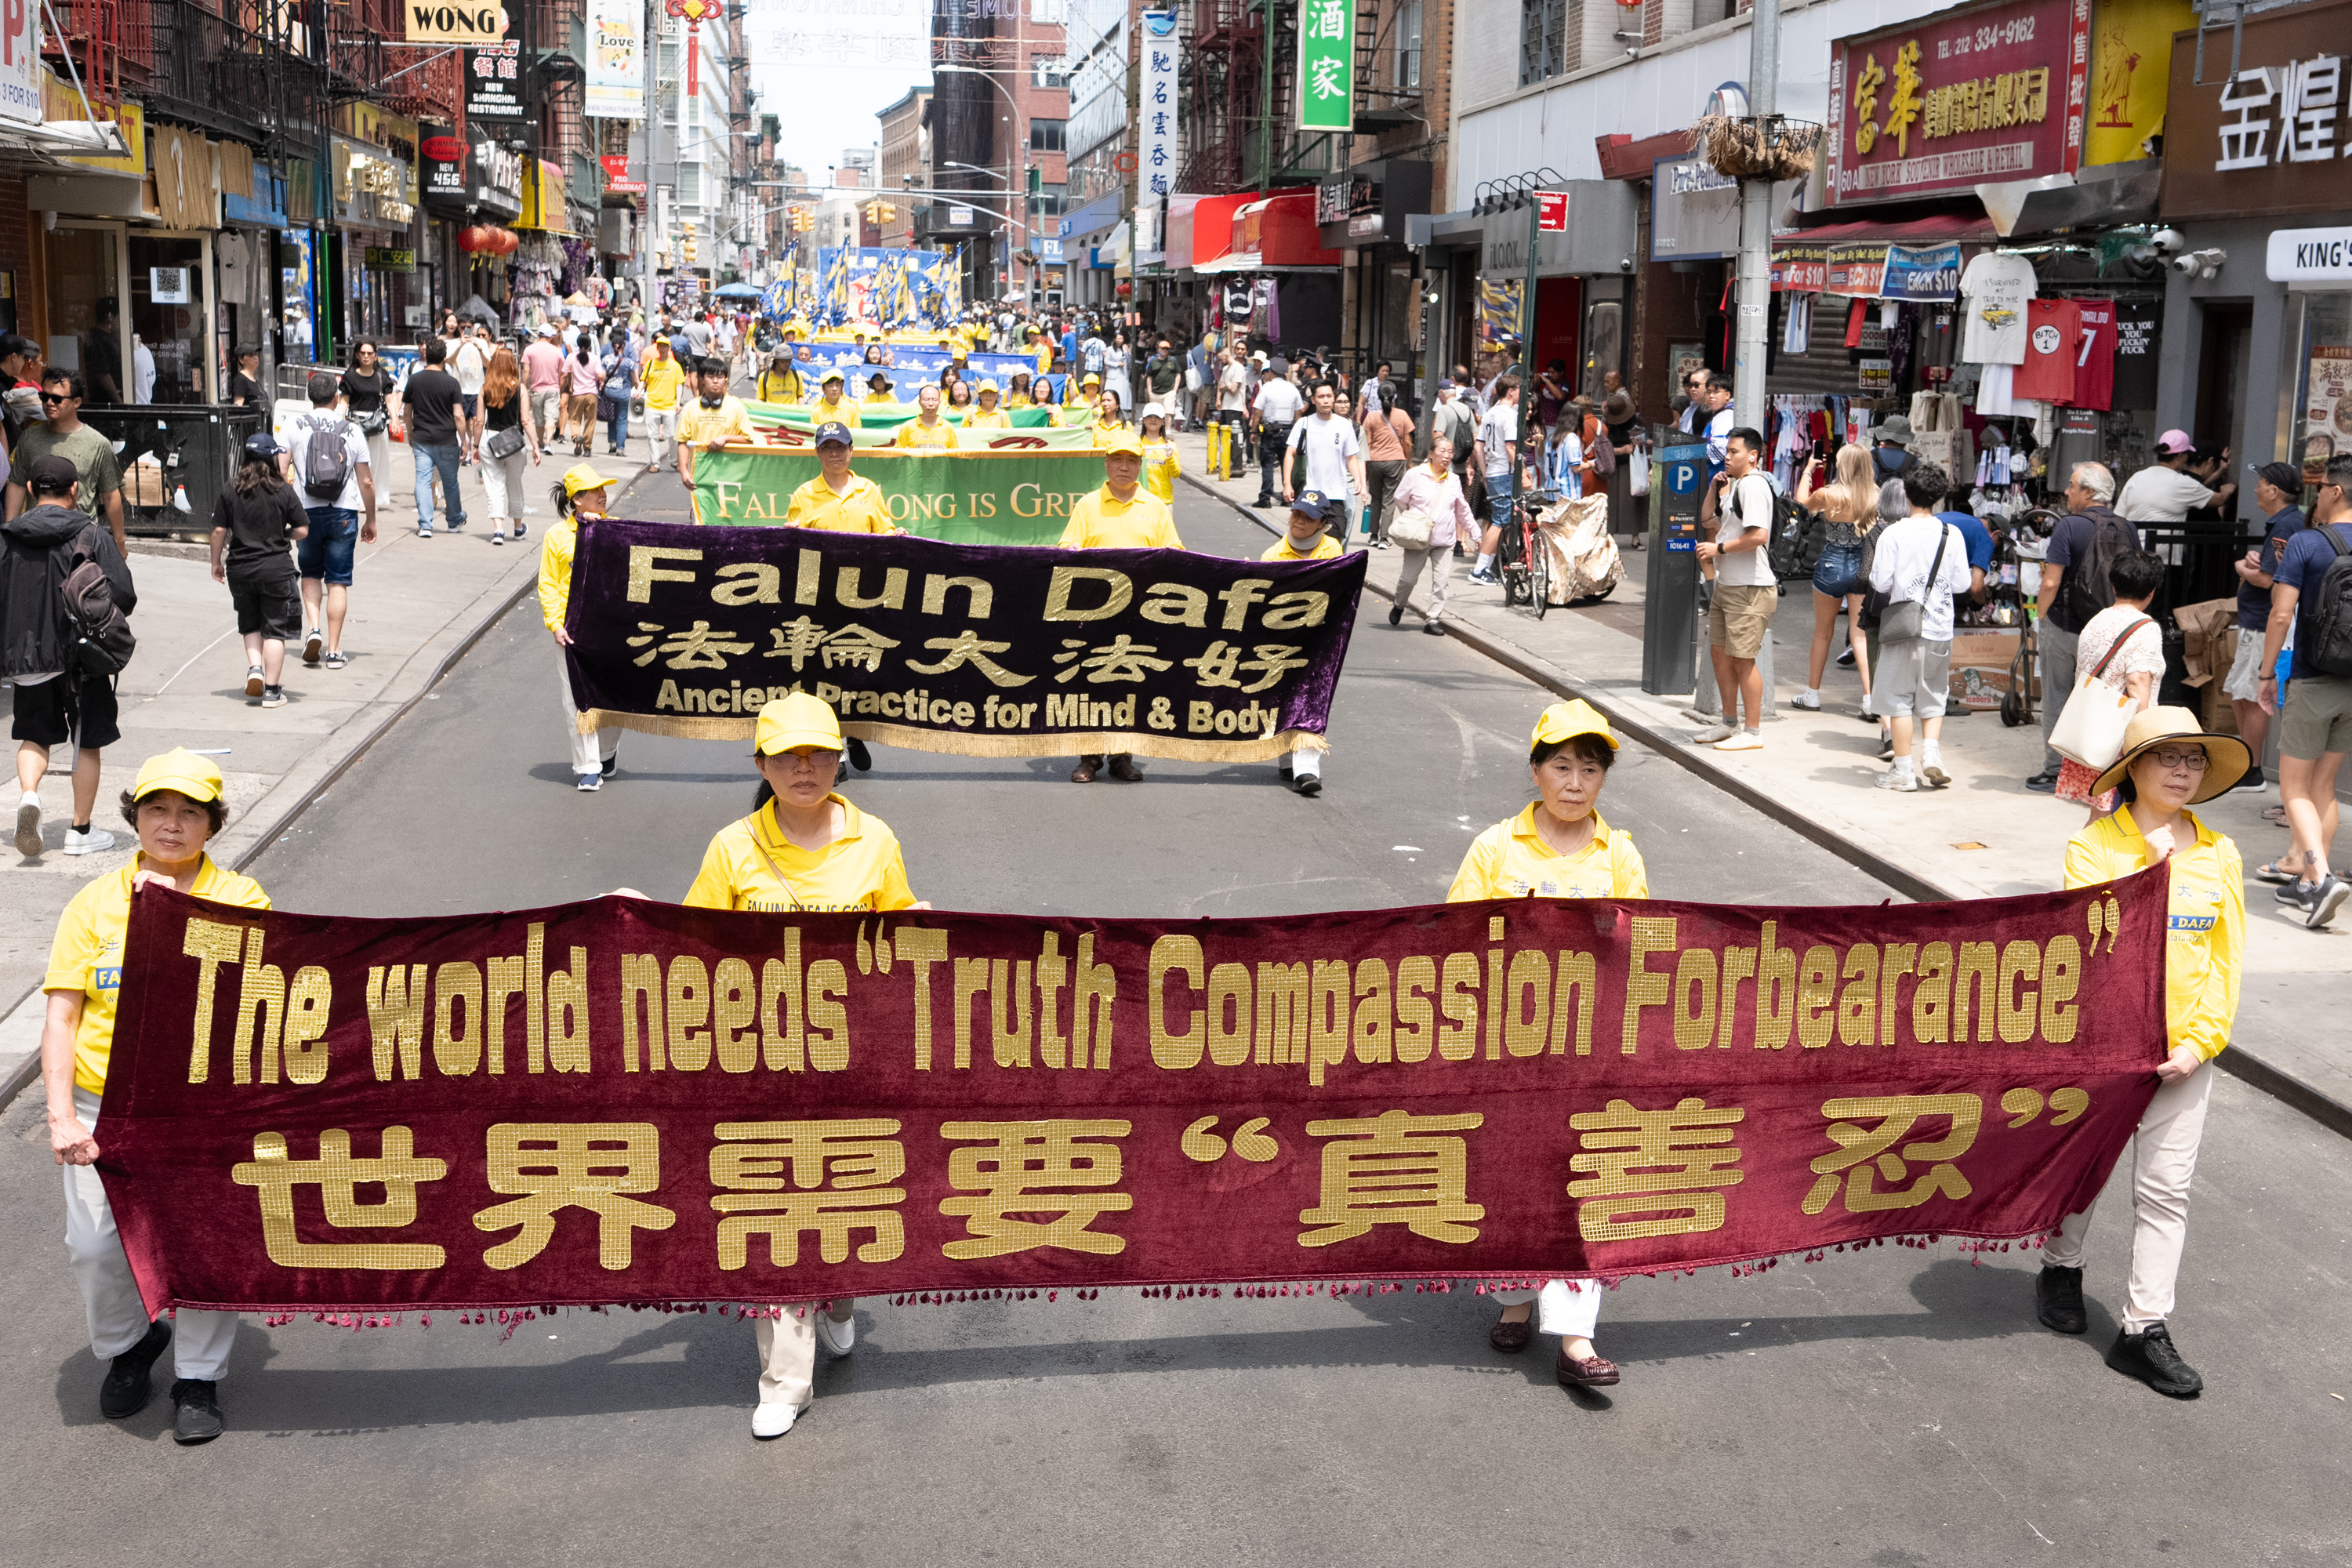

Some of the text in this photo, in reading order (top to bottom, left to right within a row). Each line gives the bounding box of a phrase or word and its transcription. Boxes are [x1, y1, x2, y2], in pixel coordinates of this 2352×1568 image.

[413, 6, 495, 34] WONG
[600, 34, 634, 47] Love
[1974, 16, 2035, 52] 334-9162
[1308, 0, 1346, 100] 酒家
[473, 57, 518, 78] 餐館
[9, 85, 25, 106] FOR
[26, 89, 39, 110] $10
[473, 93, 516, 103] SHANGHAI
[485, 82, 503, 93] NEW
[468, 103, 524, 115] RESTAURANT
[2215, 52, 2352, 172] 金煌
[439, 163, 454, 172] NEW
[1865, 165, 1880, 189] NEW
[1882, 161, 1901, 186] YORK
[1943, 149, 1984, 178] WHOLESALE
[1994, 143, 2024, 171] RETAIL
[434, 172, 461, 187] 456
[1541, 195, 1563, 205] STANDING
[1806, 265, 1824, 286] $10
[1907, 270, 1933, 292] EACH
[1935, 269, 1957, 294] $10
[1989, 278, 2021, 287] SURVIVED
[2035, 330, 2059, 341] BITCH
[2125, 330, 2142, 339] YOU
[2137, 321, 2154, 330] YOU
[2078, 328, 2096, 367] 7
[2122, 346, 2146, 354] FUCK
[1678, 468, 1693, 491] P
[713, 480, 1087, 520] FAL ONG IS GRE
[626, 544, 1330, 632] Falun Dafa
[626, 615, 1309, 694] 法輪大法好
[816, 681, 976, 728] Practice
[984, 695, 1038, 729] for
[1046, 692, 1136, 730] Mind
[1147, 696, 1176, 731] &
[1187, 699, 1279, 740] Body
[2178, 917, 2212, 929] DAFA
[183, 917, 332, 1083] The
[366, 921, 592, 1081] world
[621, 926, 851, 1073] needs
[1148, 916, 1596, 1087] Compassion
[1621, 890, 2121, 1055] Forbearance”
